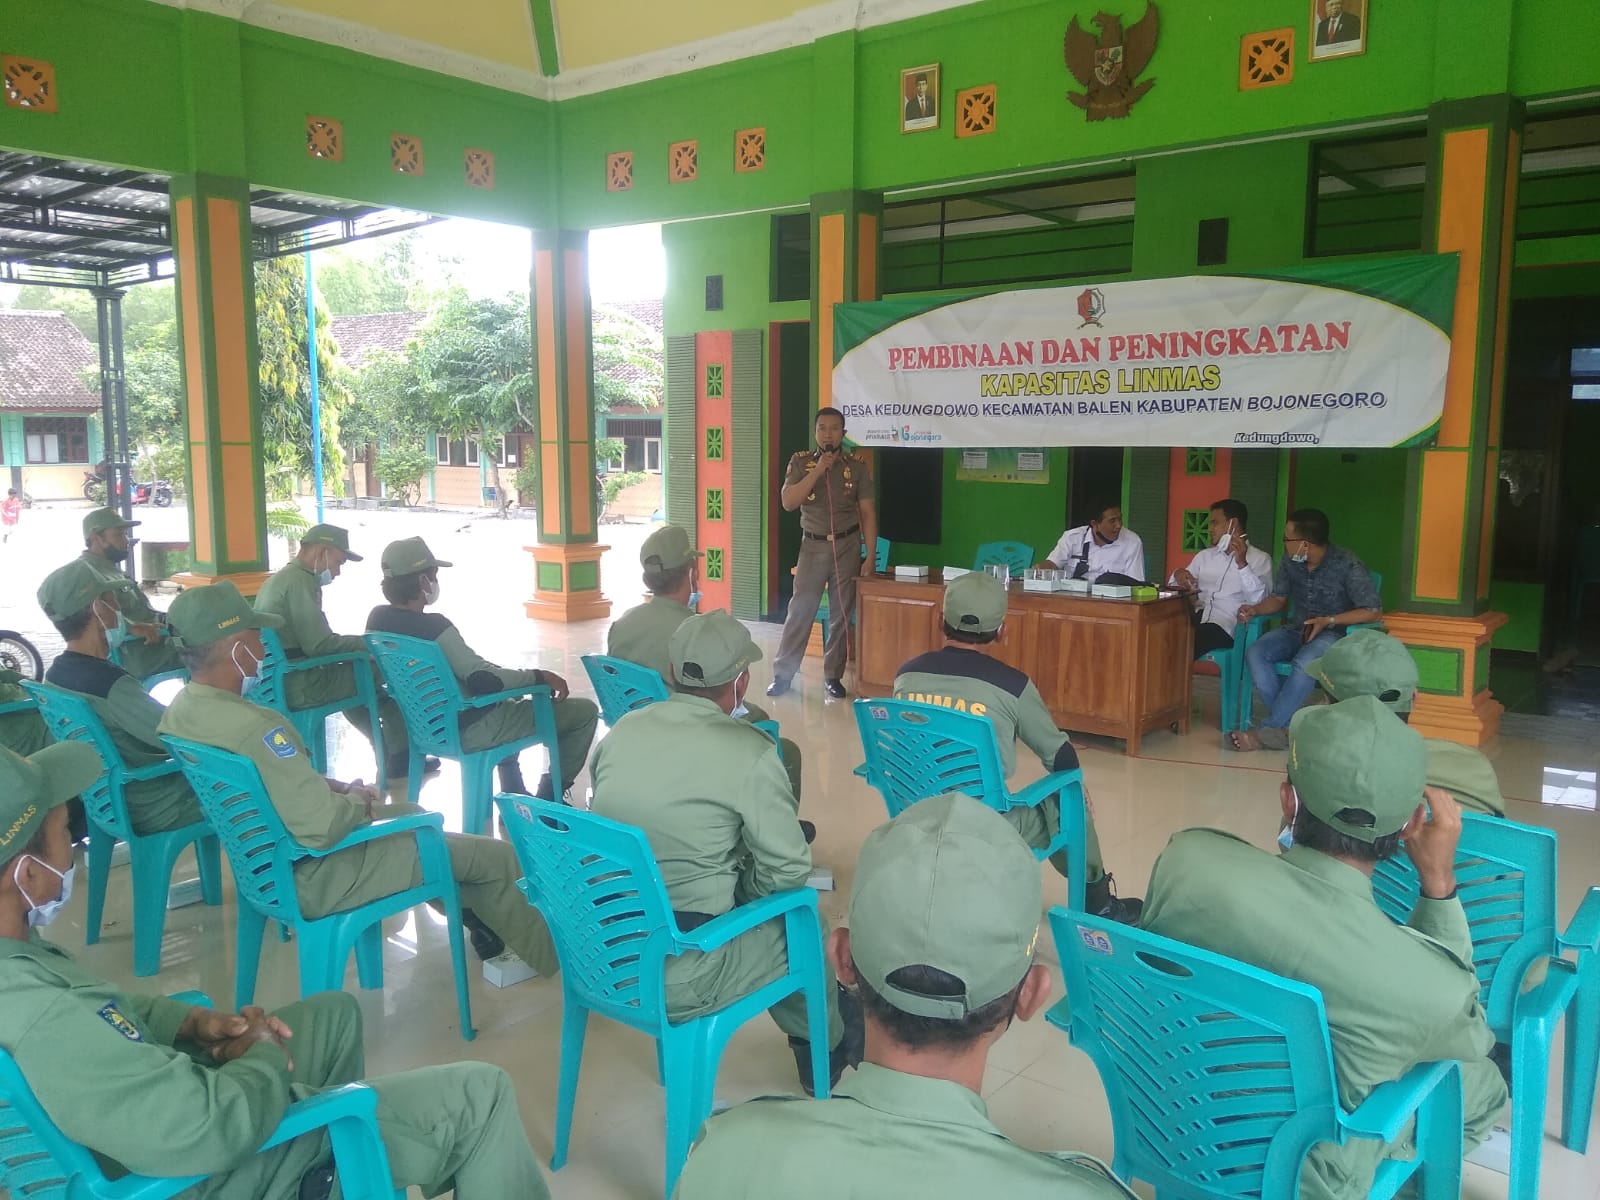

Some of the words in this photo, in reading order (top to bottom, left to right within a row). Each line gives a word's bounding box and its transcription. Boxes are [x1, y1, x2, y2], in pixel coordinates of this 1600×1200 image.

[887, 340, 1034, 371] PEMBINAAN
[1041, 336, 1101, 364] DAN
[1108, 321, 1352, 361] PENINGKATAN
[980, 369, 1111, 397] KAPASITAS
[1118, 365, 1221, 393] LINMAS
[842, 405, 873, 417] DESA
[875, 403, 979, 417] KEDUNGDOWO
[982, 401, 1074, 416] KECAMATAN
[1078, 400, 1132, 414] BALEN
[1137, 397, 1243, 413] KABUPATEN
[1247, 392, 1386, 410] BOJONEGORO
[1234, 432, 1320, 445] Kedungdowo,
